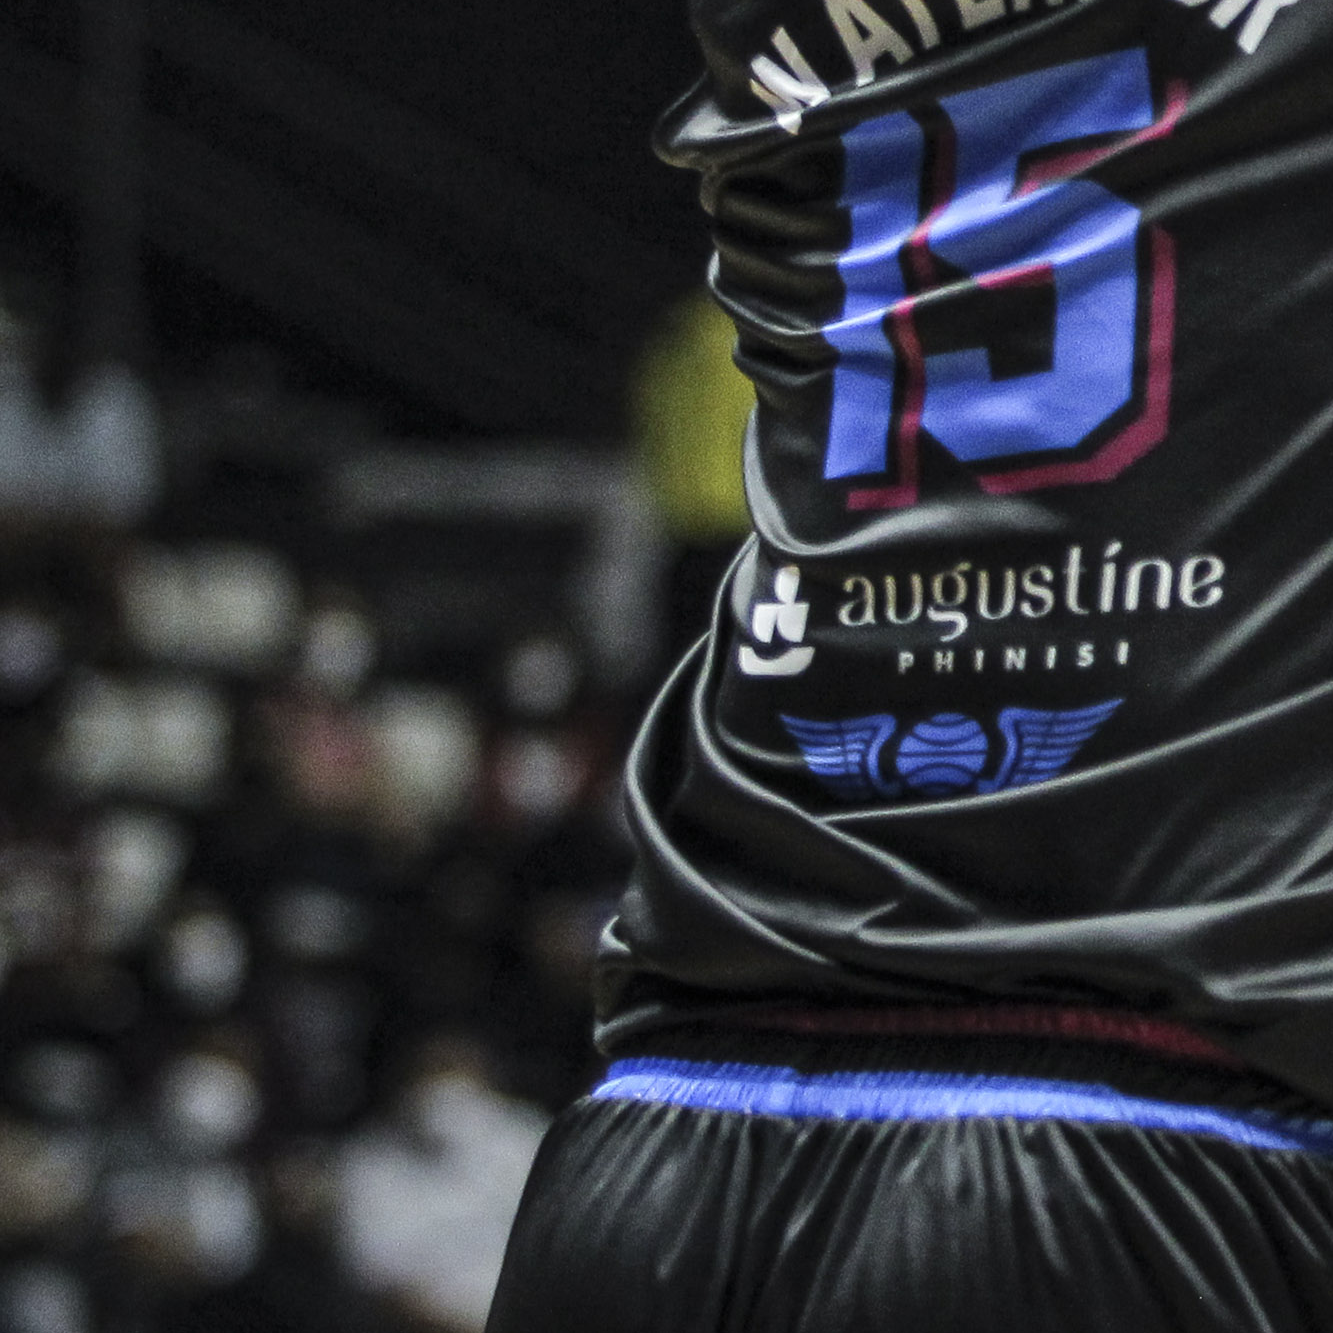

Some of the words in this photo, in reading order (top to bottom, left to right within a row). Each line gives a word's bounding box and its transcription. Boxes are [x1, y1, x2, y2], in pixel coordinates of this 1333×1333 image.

[822, 47, 1180, 507] 15
[838, 540, 1226, 643] augustine
[897, 640, 1131, 673] PHINISI
